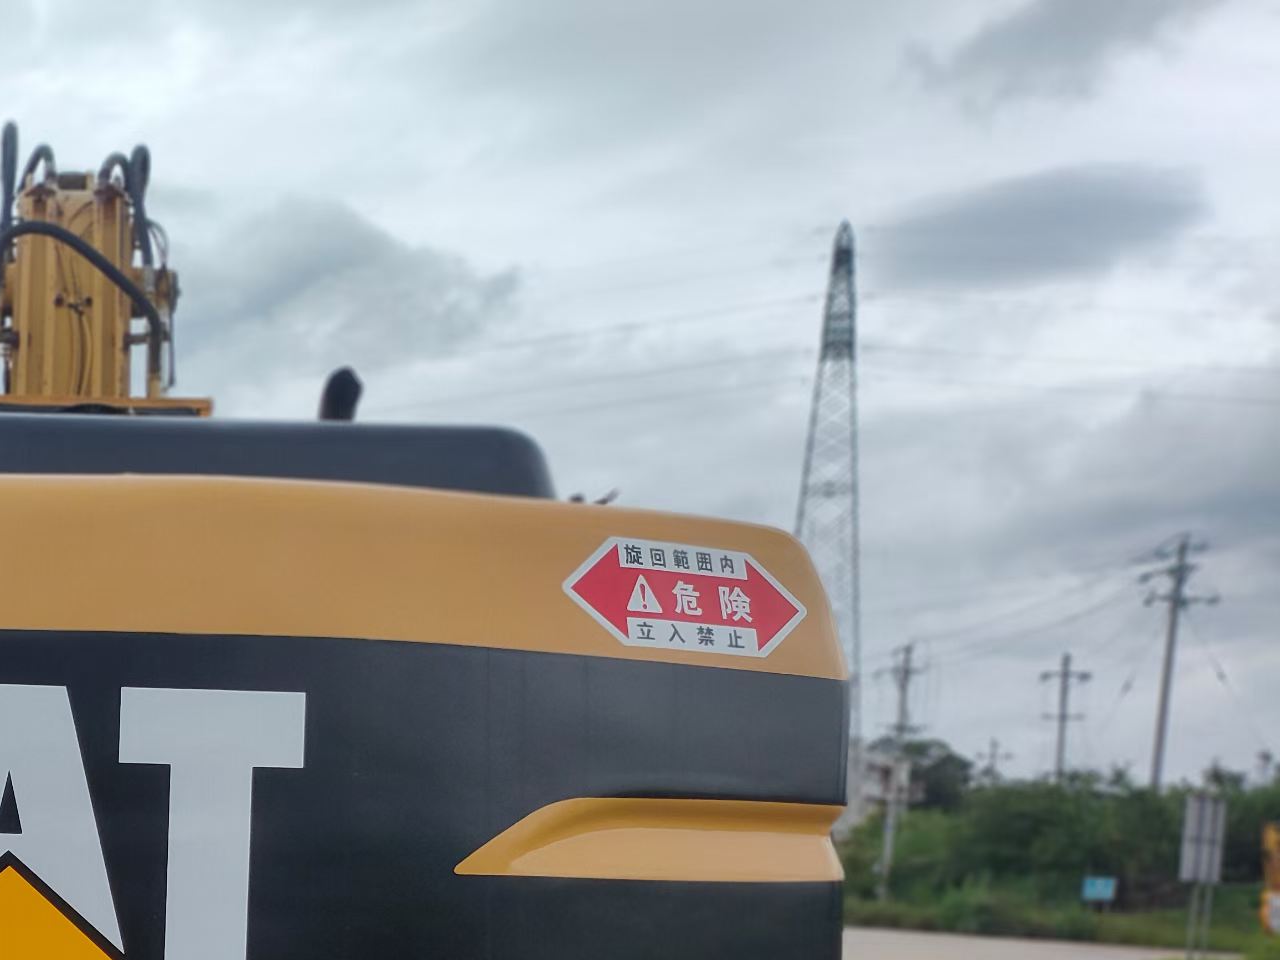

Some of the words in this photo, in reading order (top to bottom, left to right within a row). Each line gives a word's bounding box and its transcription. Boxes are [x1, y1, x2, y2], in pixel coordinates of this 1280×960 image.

[624, 544, 735, 574] 旋回範囲内
[672, 580, 753, 623] 危険
[636, 621, 745, 649] 立入禁止
